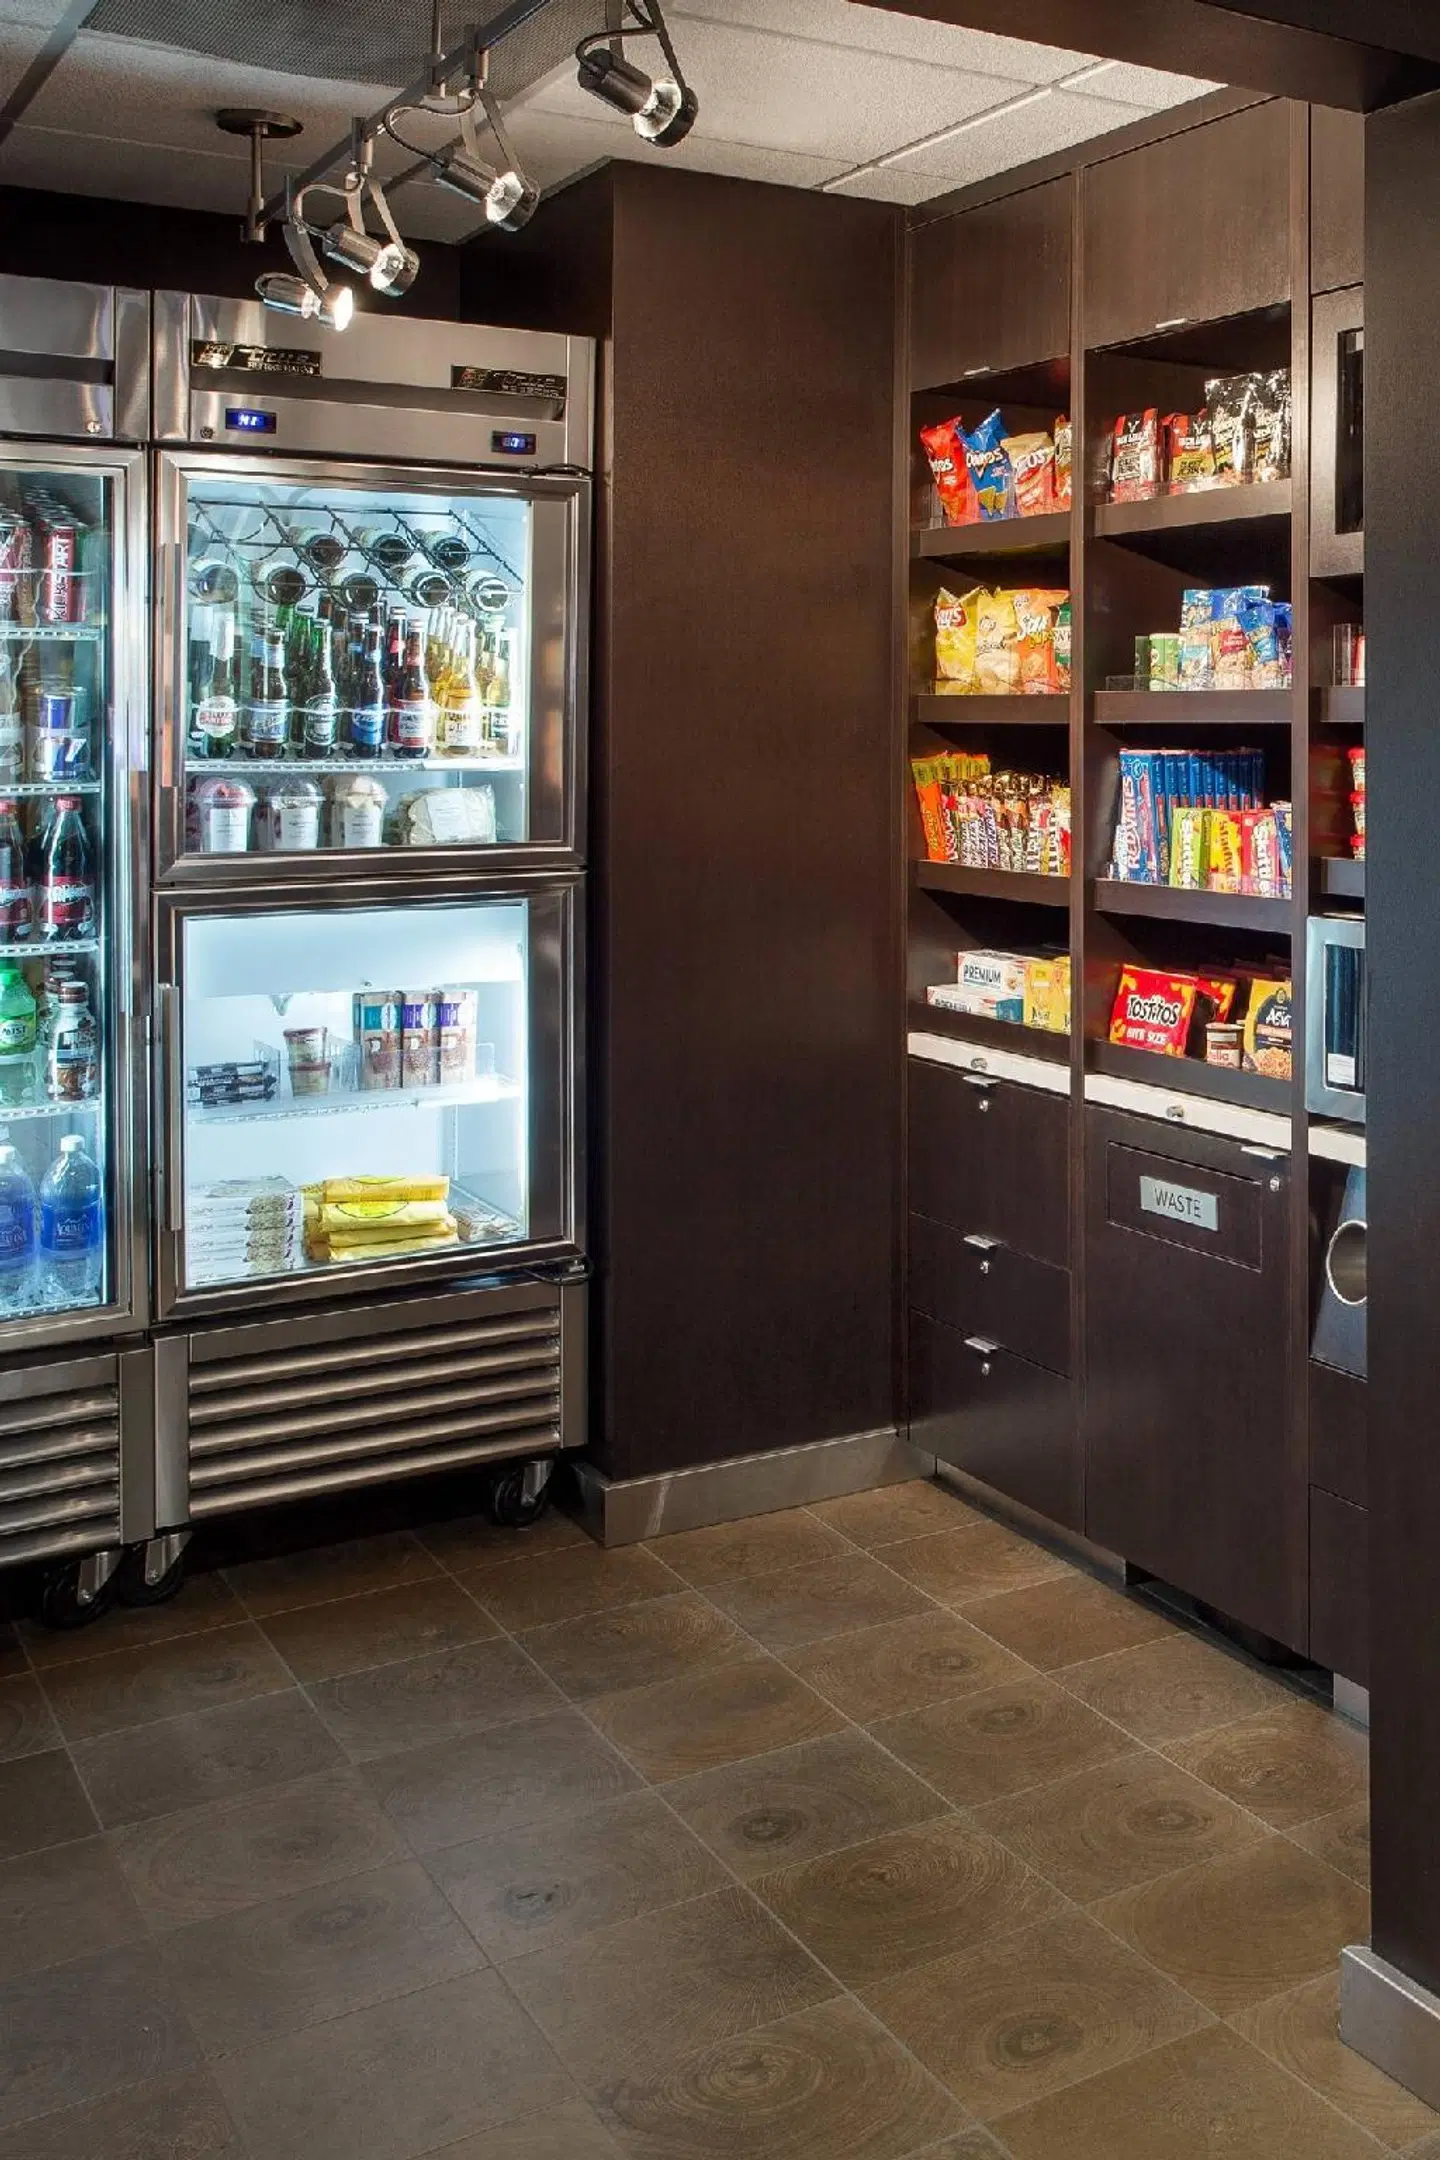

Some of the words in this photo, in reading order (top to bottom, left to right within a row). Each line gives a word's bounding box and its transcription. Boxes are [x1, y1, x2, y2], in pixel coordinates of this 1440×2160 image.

[1181, 816, 1198, 889] Skittle
[1253, 822, 1273, 896] Skittle
[963, 964, 1001, 983] PREMIUM
[1127, 994, 1182, 1027] TOSTITOS
[1126, 1027, 1145, 1041] BITE
[1147, 1031, 1168, 1046] SIZE
[1153, 1185, 1202, 1219] WASTE
